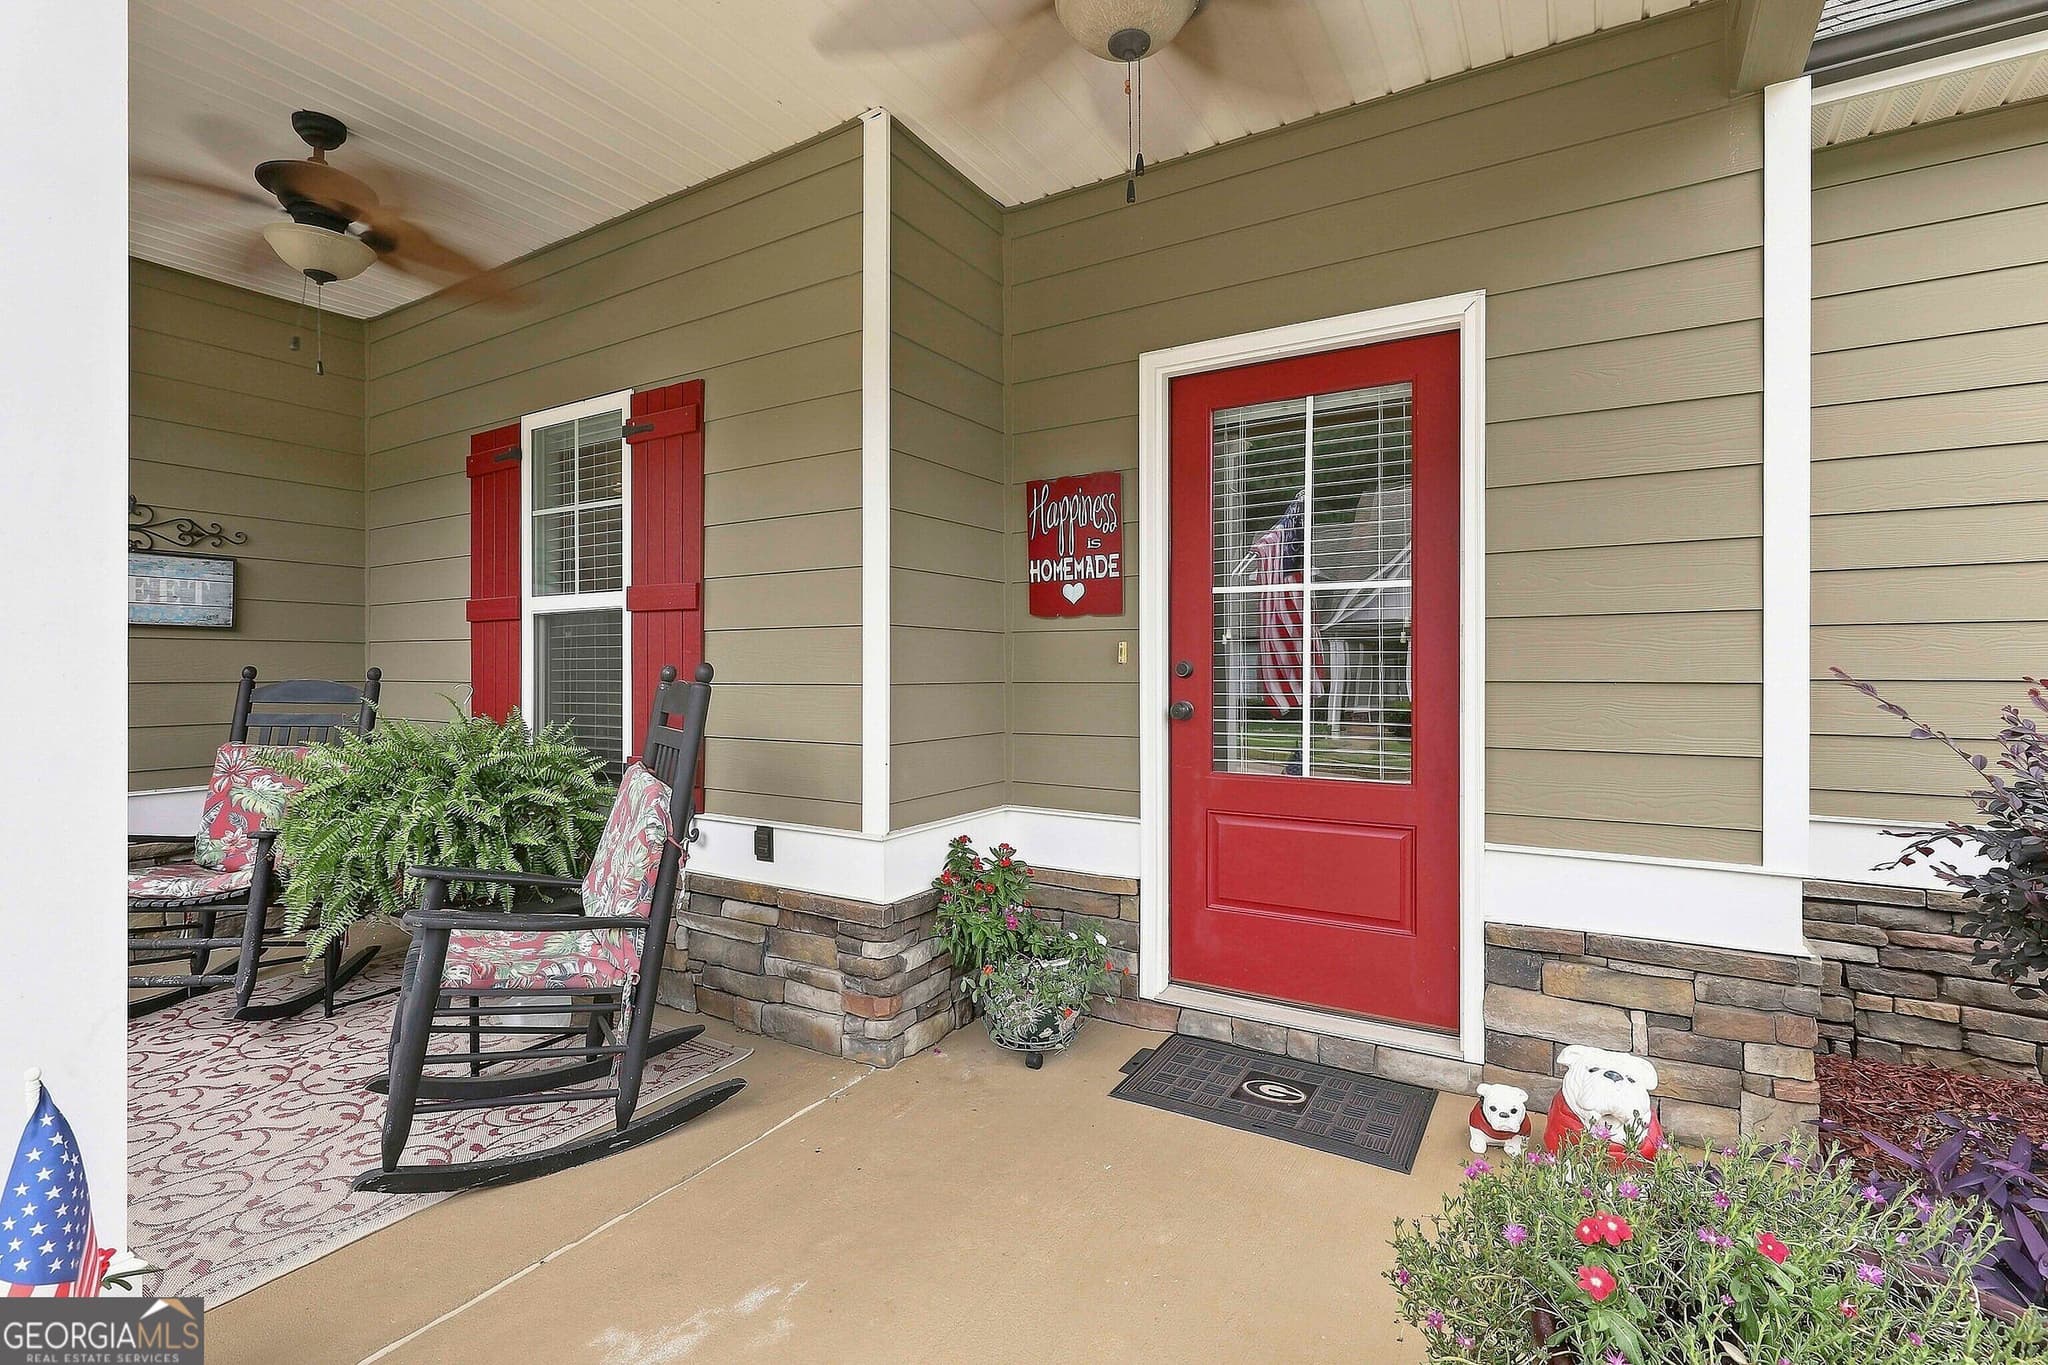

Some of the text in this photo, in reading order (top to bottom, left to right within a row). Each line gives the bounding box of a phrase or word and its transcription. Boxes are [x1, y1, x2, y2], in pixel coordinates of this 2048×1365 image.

[1029, 484, 1118, 556] Happiness
[1087, 537, 1101, 549] is
[1029, 553, 1120, 583] HOMEMADE
[1243, 1080, 1306, 1103] G
